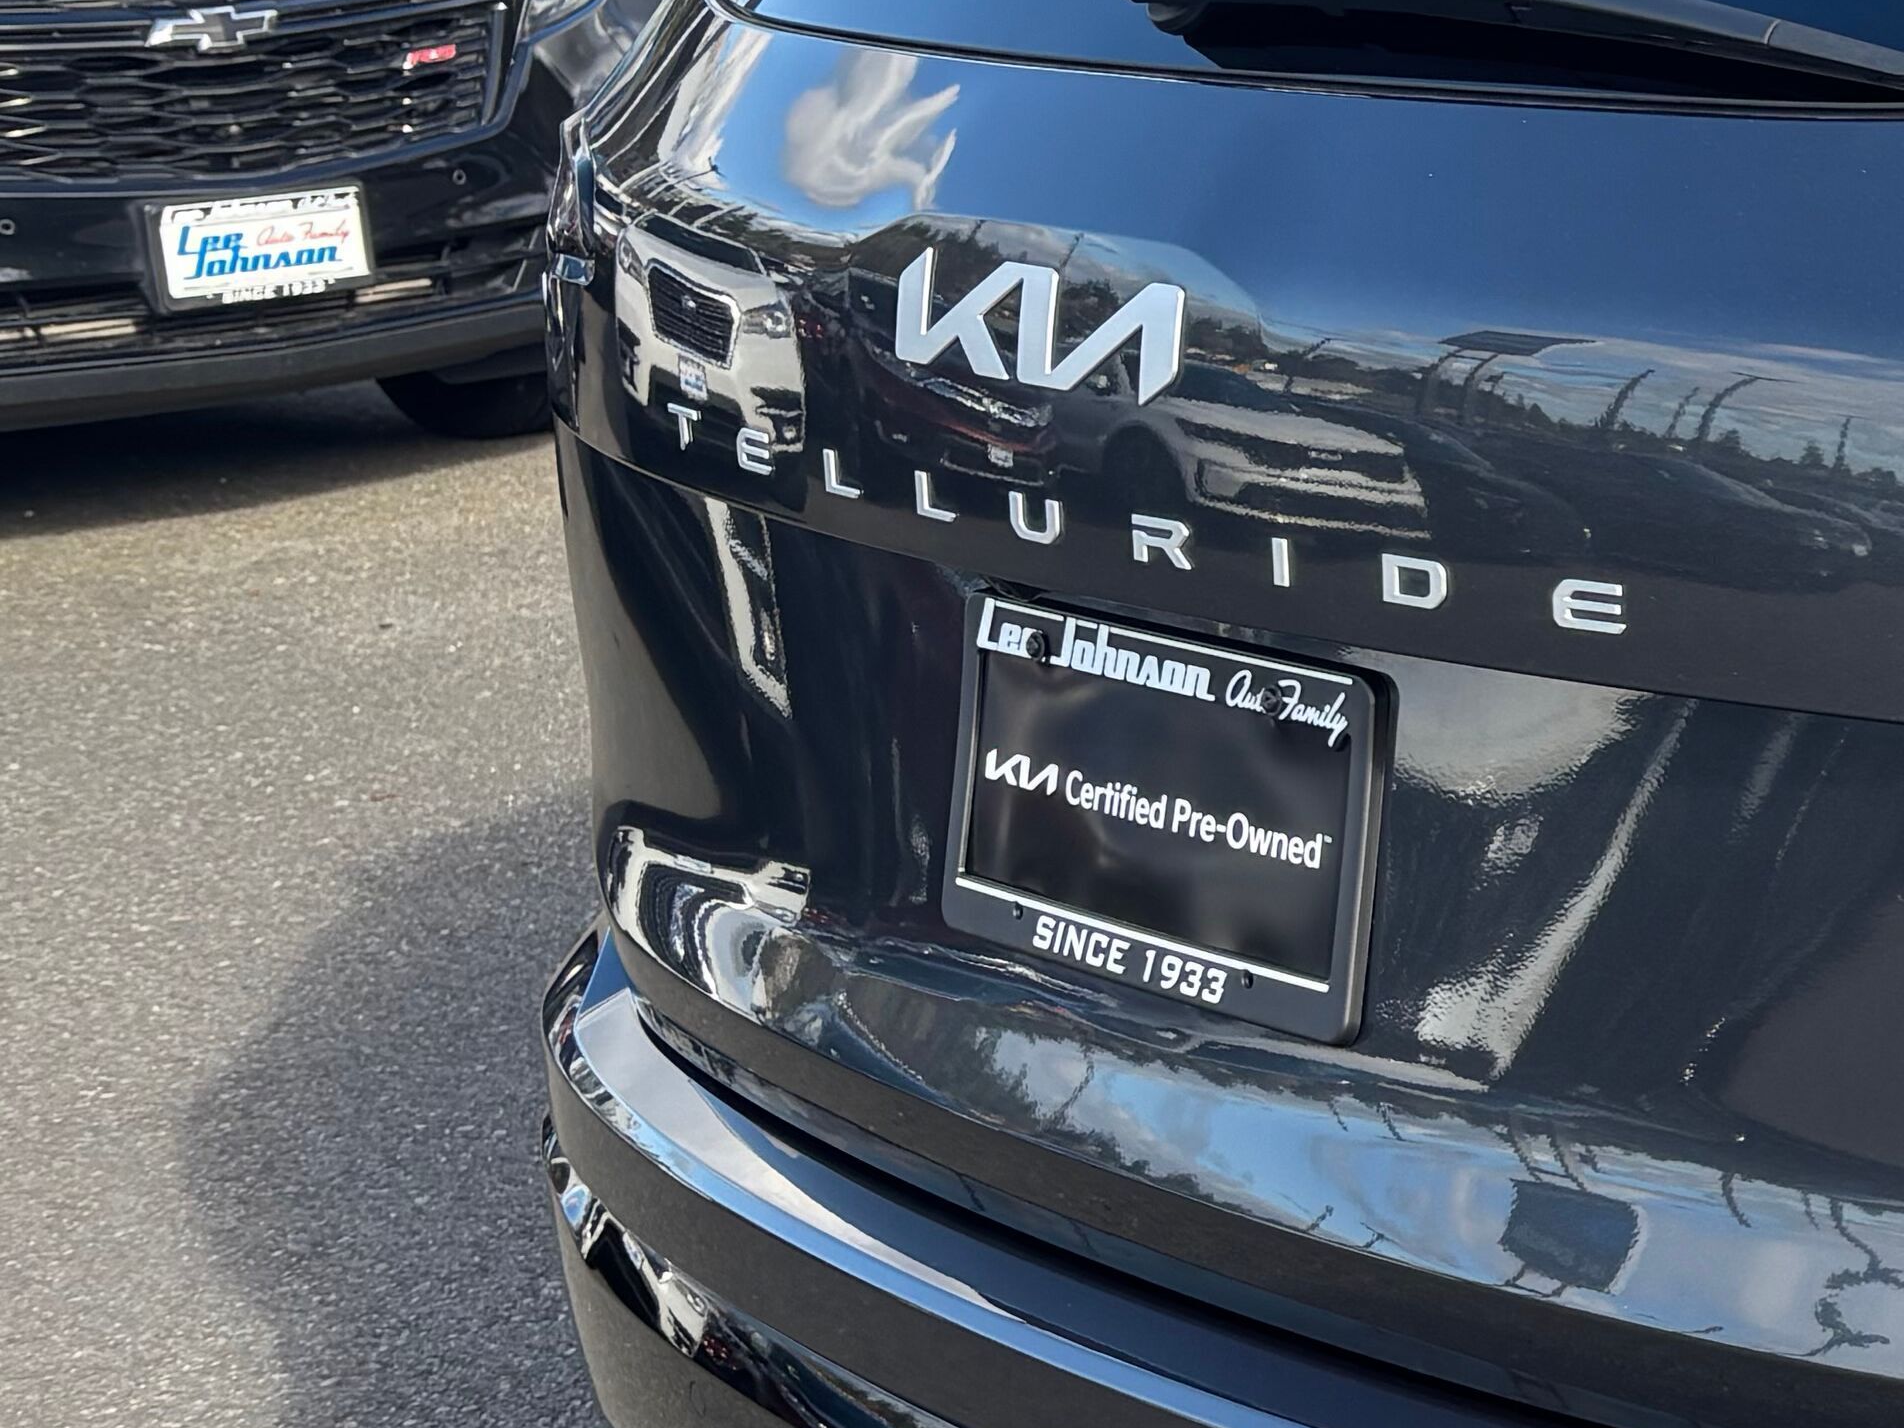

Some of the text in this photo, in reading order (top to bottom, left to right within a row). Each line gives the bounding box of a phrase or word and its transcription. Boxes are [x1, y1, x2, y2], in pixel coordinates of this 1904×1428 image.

[177, 225, 247, 256] Lee
[183, 236, 343, 281] Johnson
[895, 246, 1187, 406] KIA
[666, 401, 1629, 636] TELLURIDE
[1049, 616, 1217, 703] Johnson
[1225, 669, 1278, 715] Aut
[1277, 678, 1349, 748] Family
[985, 748, 1060, 797] KIA
[1065, 769, 1169, 831] Certified
[1032, 915, 1229, 1005] SINCE 1933
